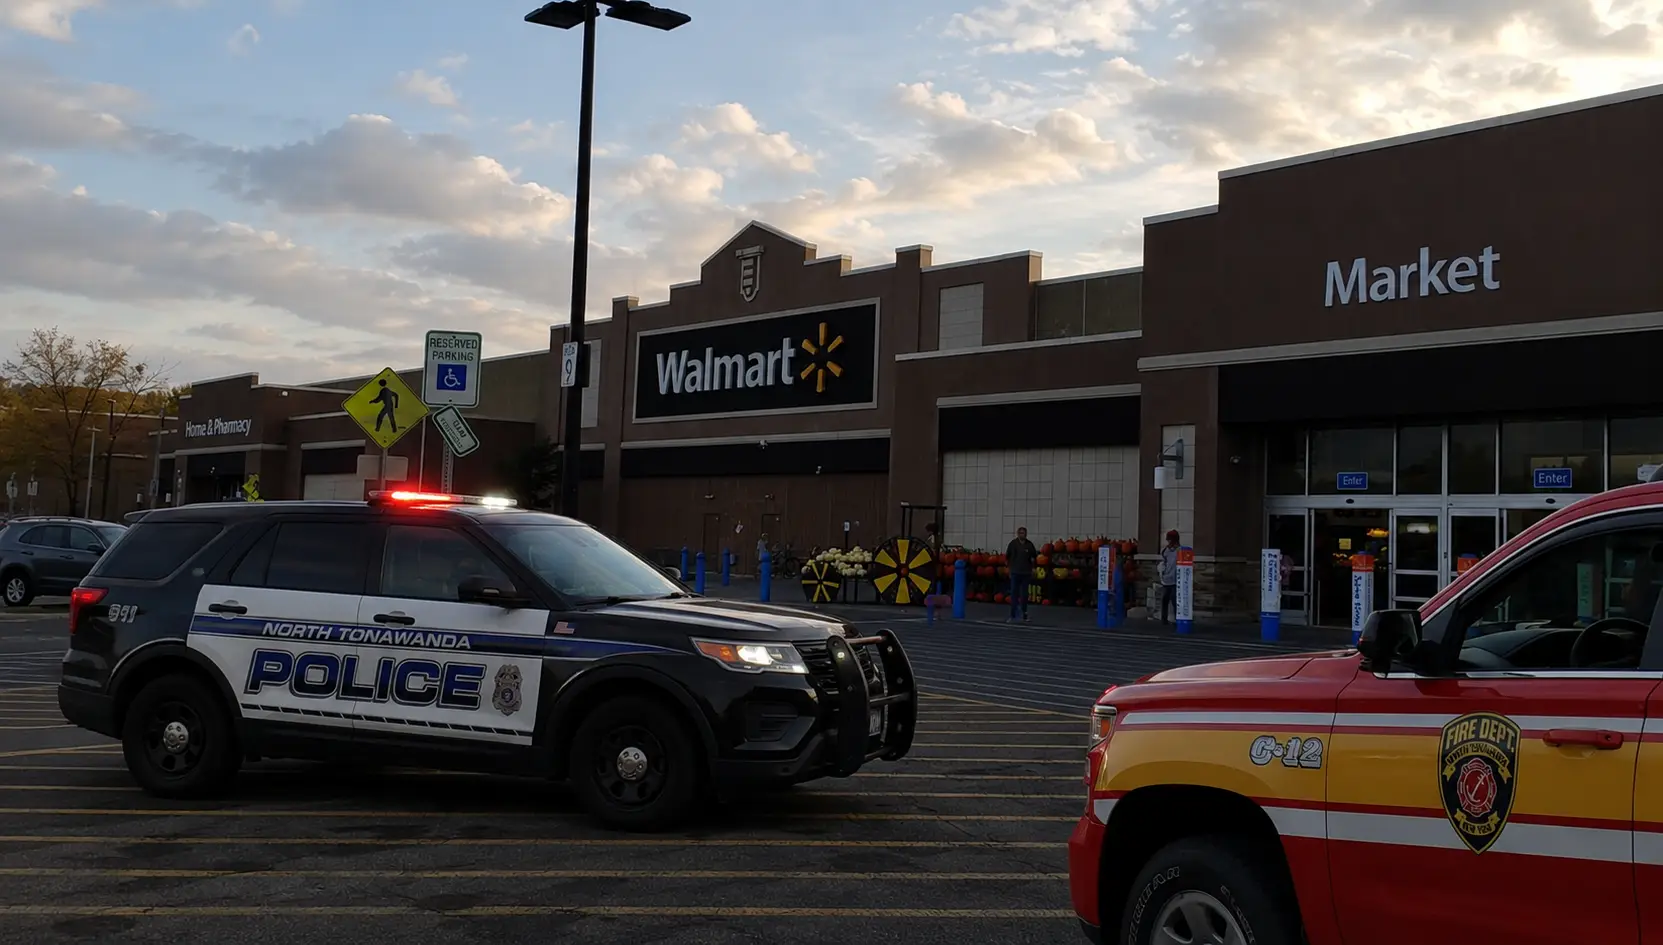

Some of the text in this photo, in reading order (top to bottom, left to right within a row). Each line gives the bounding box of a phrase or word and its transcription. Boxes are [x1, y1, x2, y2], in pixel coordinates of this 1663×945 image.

[1324, 245, 1501, 308] Market
[429, 337, 478, 349] RESERVED
[432, 350, 475, 361] PARKING
[656, 336, 797, 396] Walmart
[185, 417, 252, 438] Home & Pharmacy
[1343, 475, 1364, 486] Enter
[1538, 472, 1568, 484] Enter
[262, 622, 472, 650] NORTH TONAWANDA
[244, 647, 487, 710] POLICE
[1445, 718, 1516, 753] FIRE DEPT.
[1249, 735, 1323, 769] C-12
